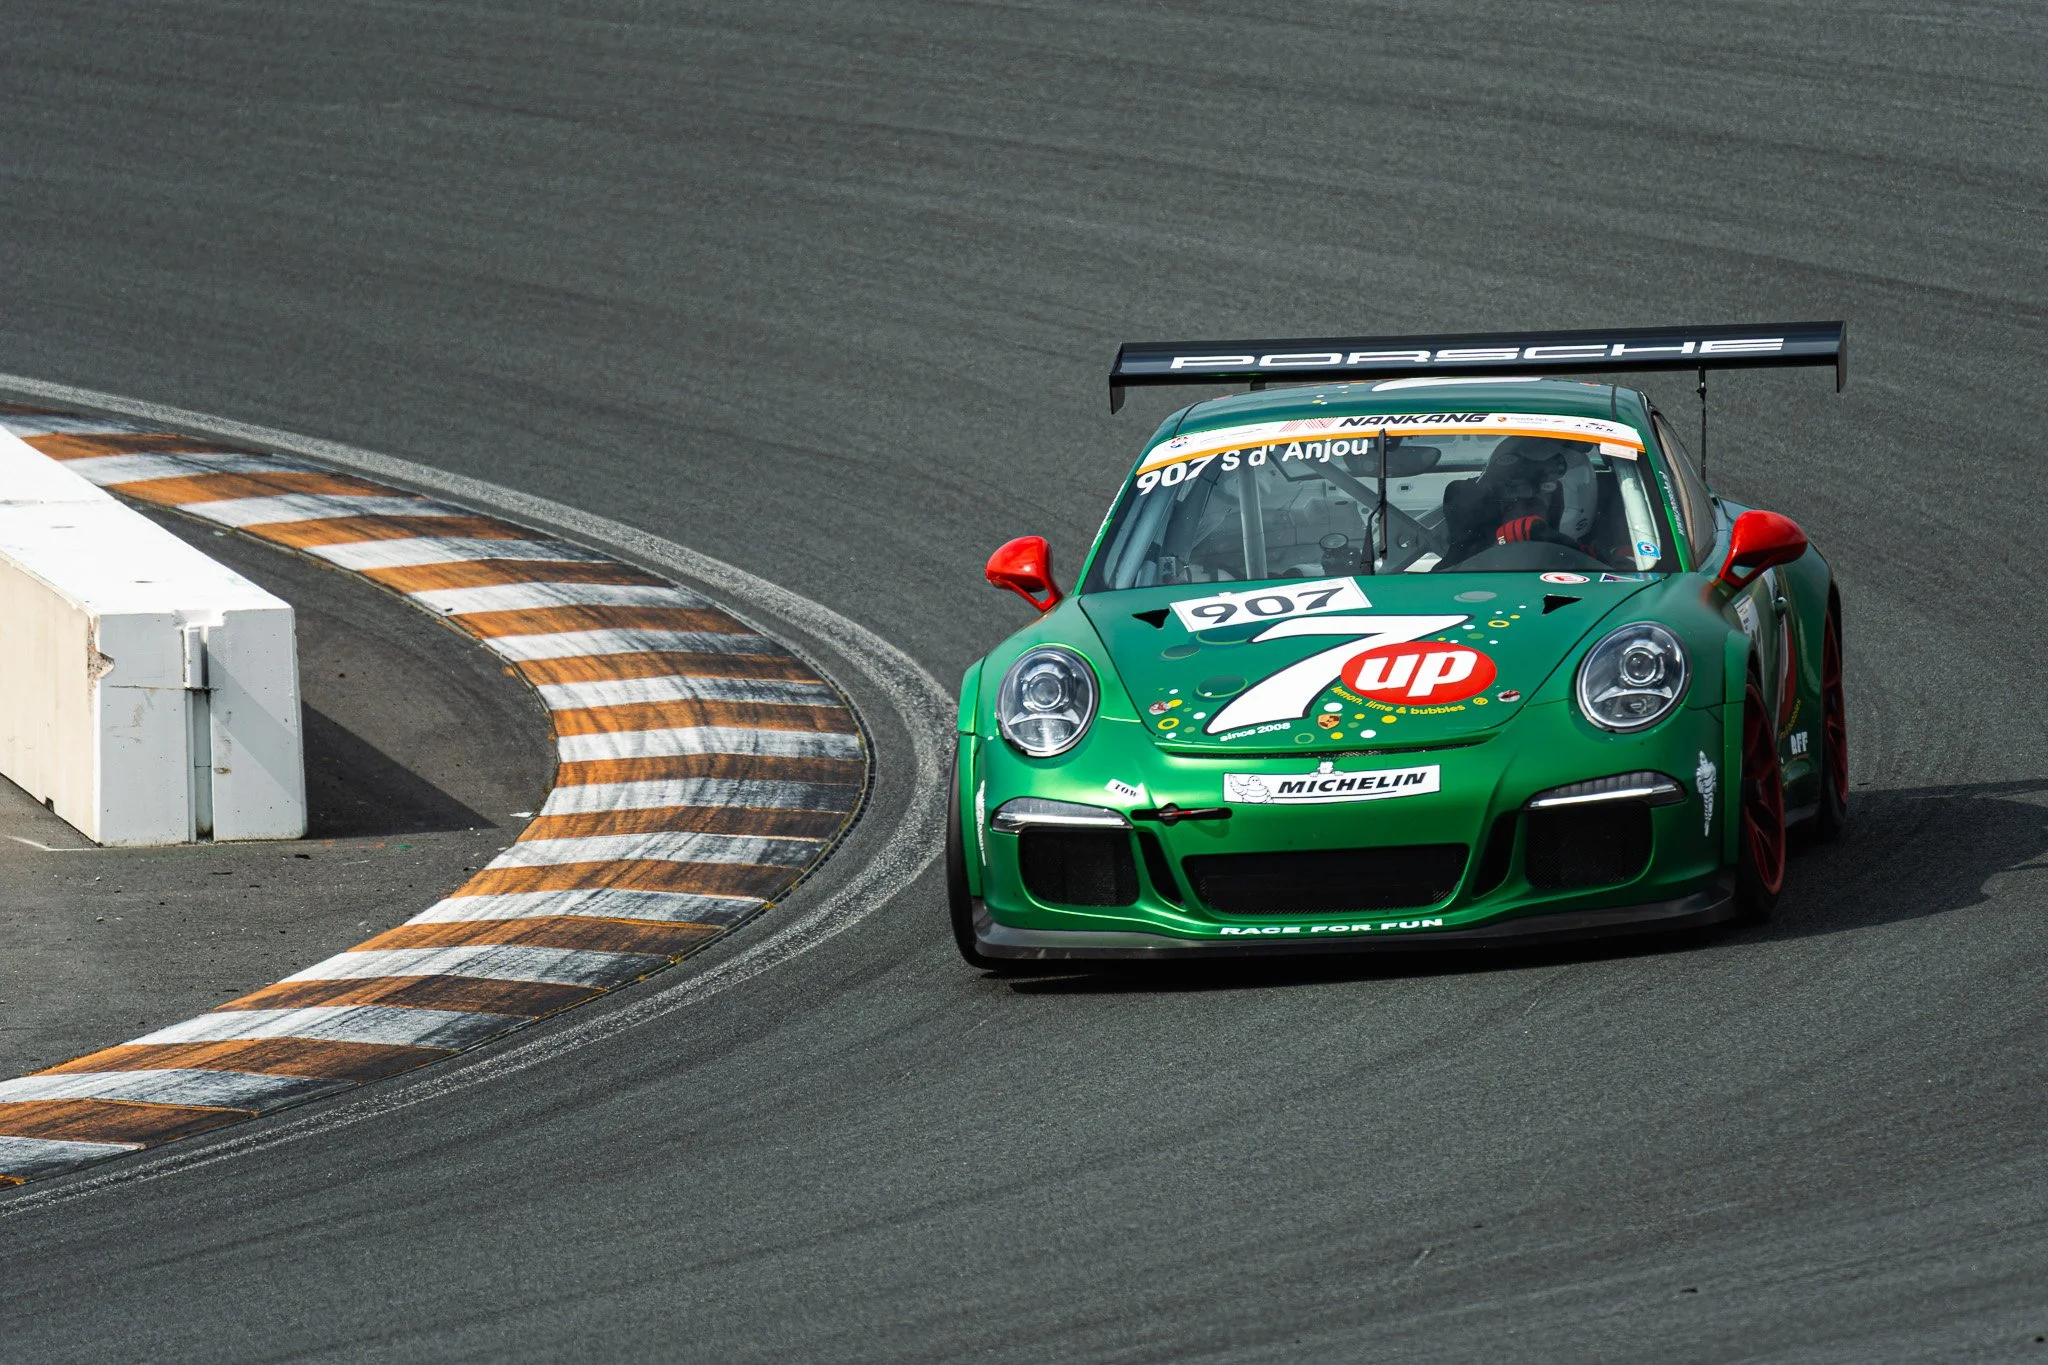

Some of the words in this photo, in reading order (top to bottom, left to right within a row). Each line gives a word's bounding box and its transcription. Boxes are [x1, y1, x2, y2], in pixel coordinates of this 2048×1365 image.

[1170, 337, 1784, 369] PORSCHE
[1339, 413, 1489, 428] NANKANG
[1136, 454, 1218, 496] 907
[1221, 450, 1240, 472] S
[1248, 444, 1275, 467] d'
[1282, 439, 1368, 464] Anjou
[1191, 587, 1344, 624] 907
[1203, 614, 1474, 735] 7
[1355, 650, 1478, 697] up
[1365, 701, 1393, 712] lime
[1396, 706, 1406, 714] &
[1410, 705, 1466, 715] bubbles
[1220, 729, 1256, 742] since
[1257, 722, 1291, 735] 2008
[1113, 782, 1140, 798] TOW
[1277, 772, 1427, 794] MICHELIN
[1220, 926, 1301, 935] RACE
[1310, 923, 1372, 933] FOR
[1380, 918, 1443, 930] FUN
